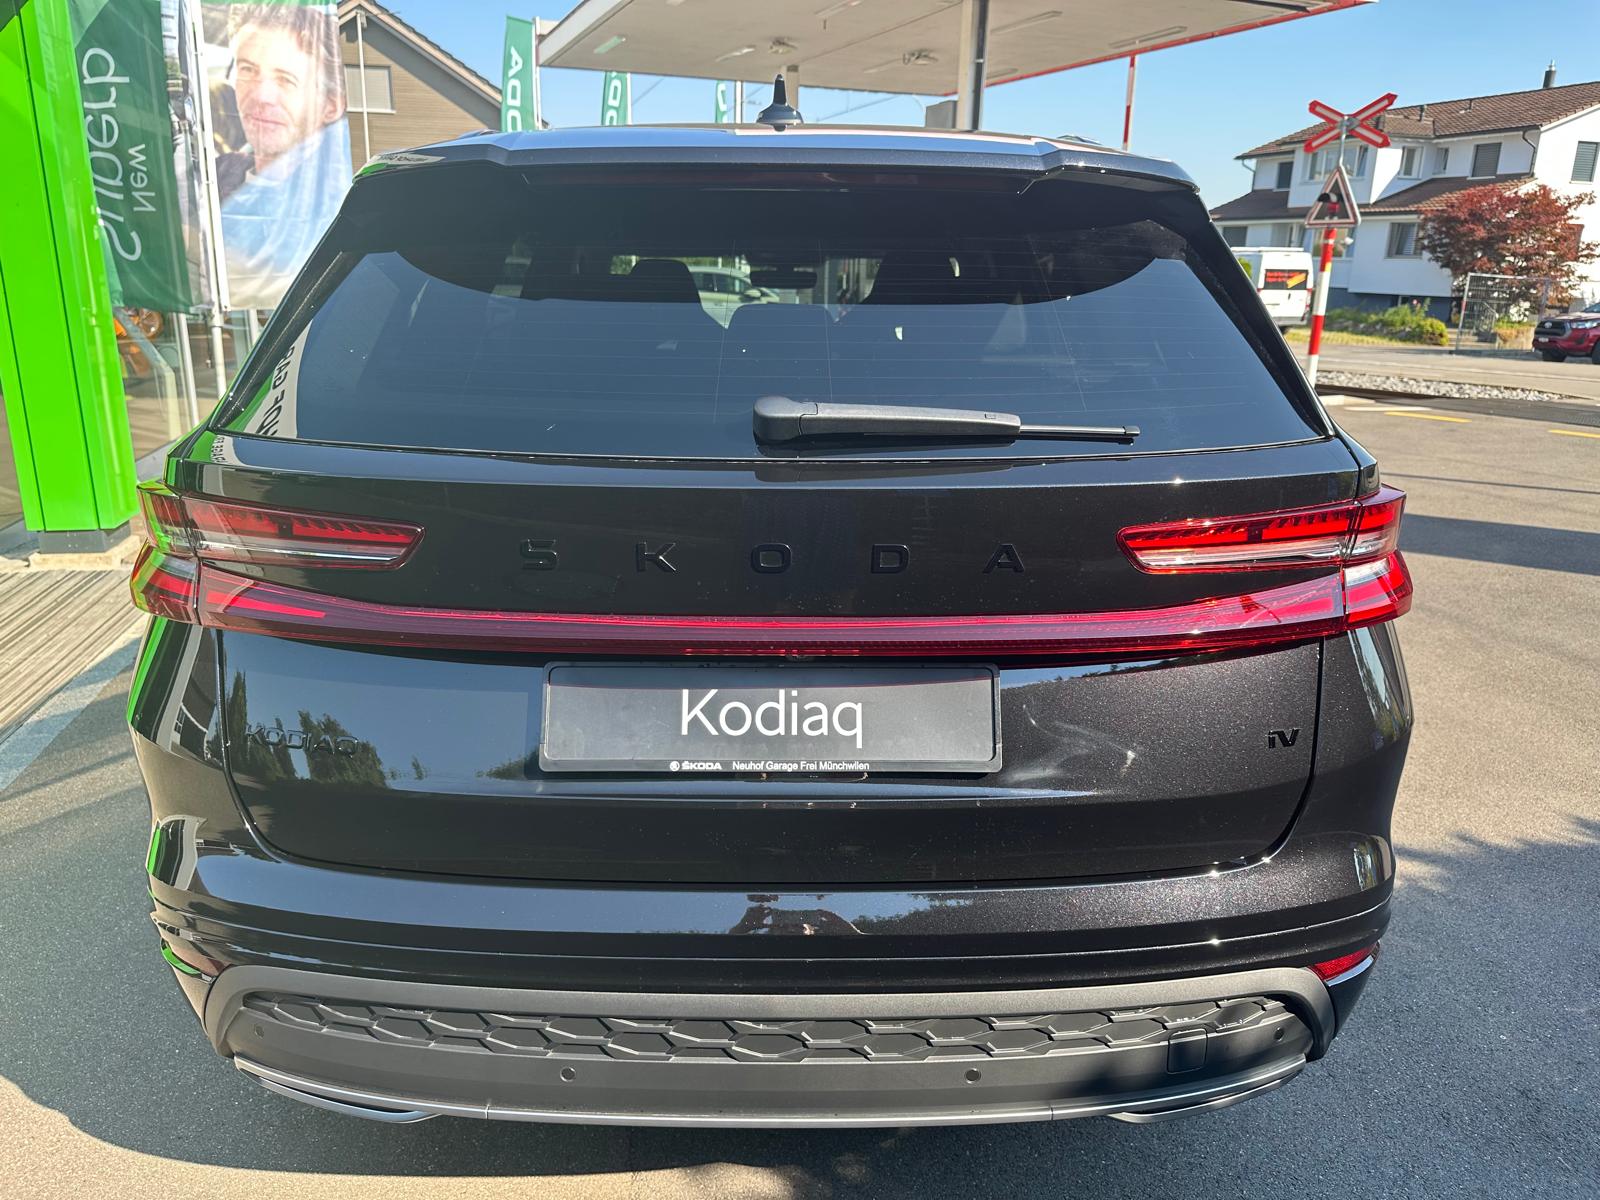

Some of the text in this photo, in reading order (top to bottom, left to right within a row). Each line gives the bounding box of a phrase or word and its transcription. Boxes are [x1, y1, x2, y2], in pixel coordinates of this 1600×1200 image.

[681, 688, 863, 749] Kodiaq
[246, 724, 359, 758] KODIAQ
[1266, 728, 1301, 748] iV
[682, 760, 870, 772] ŠKODA Neuhof Garage Frei Münchwilen
